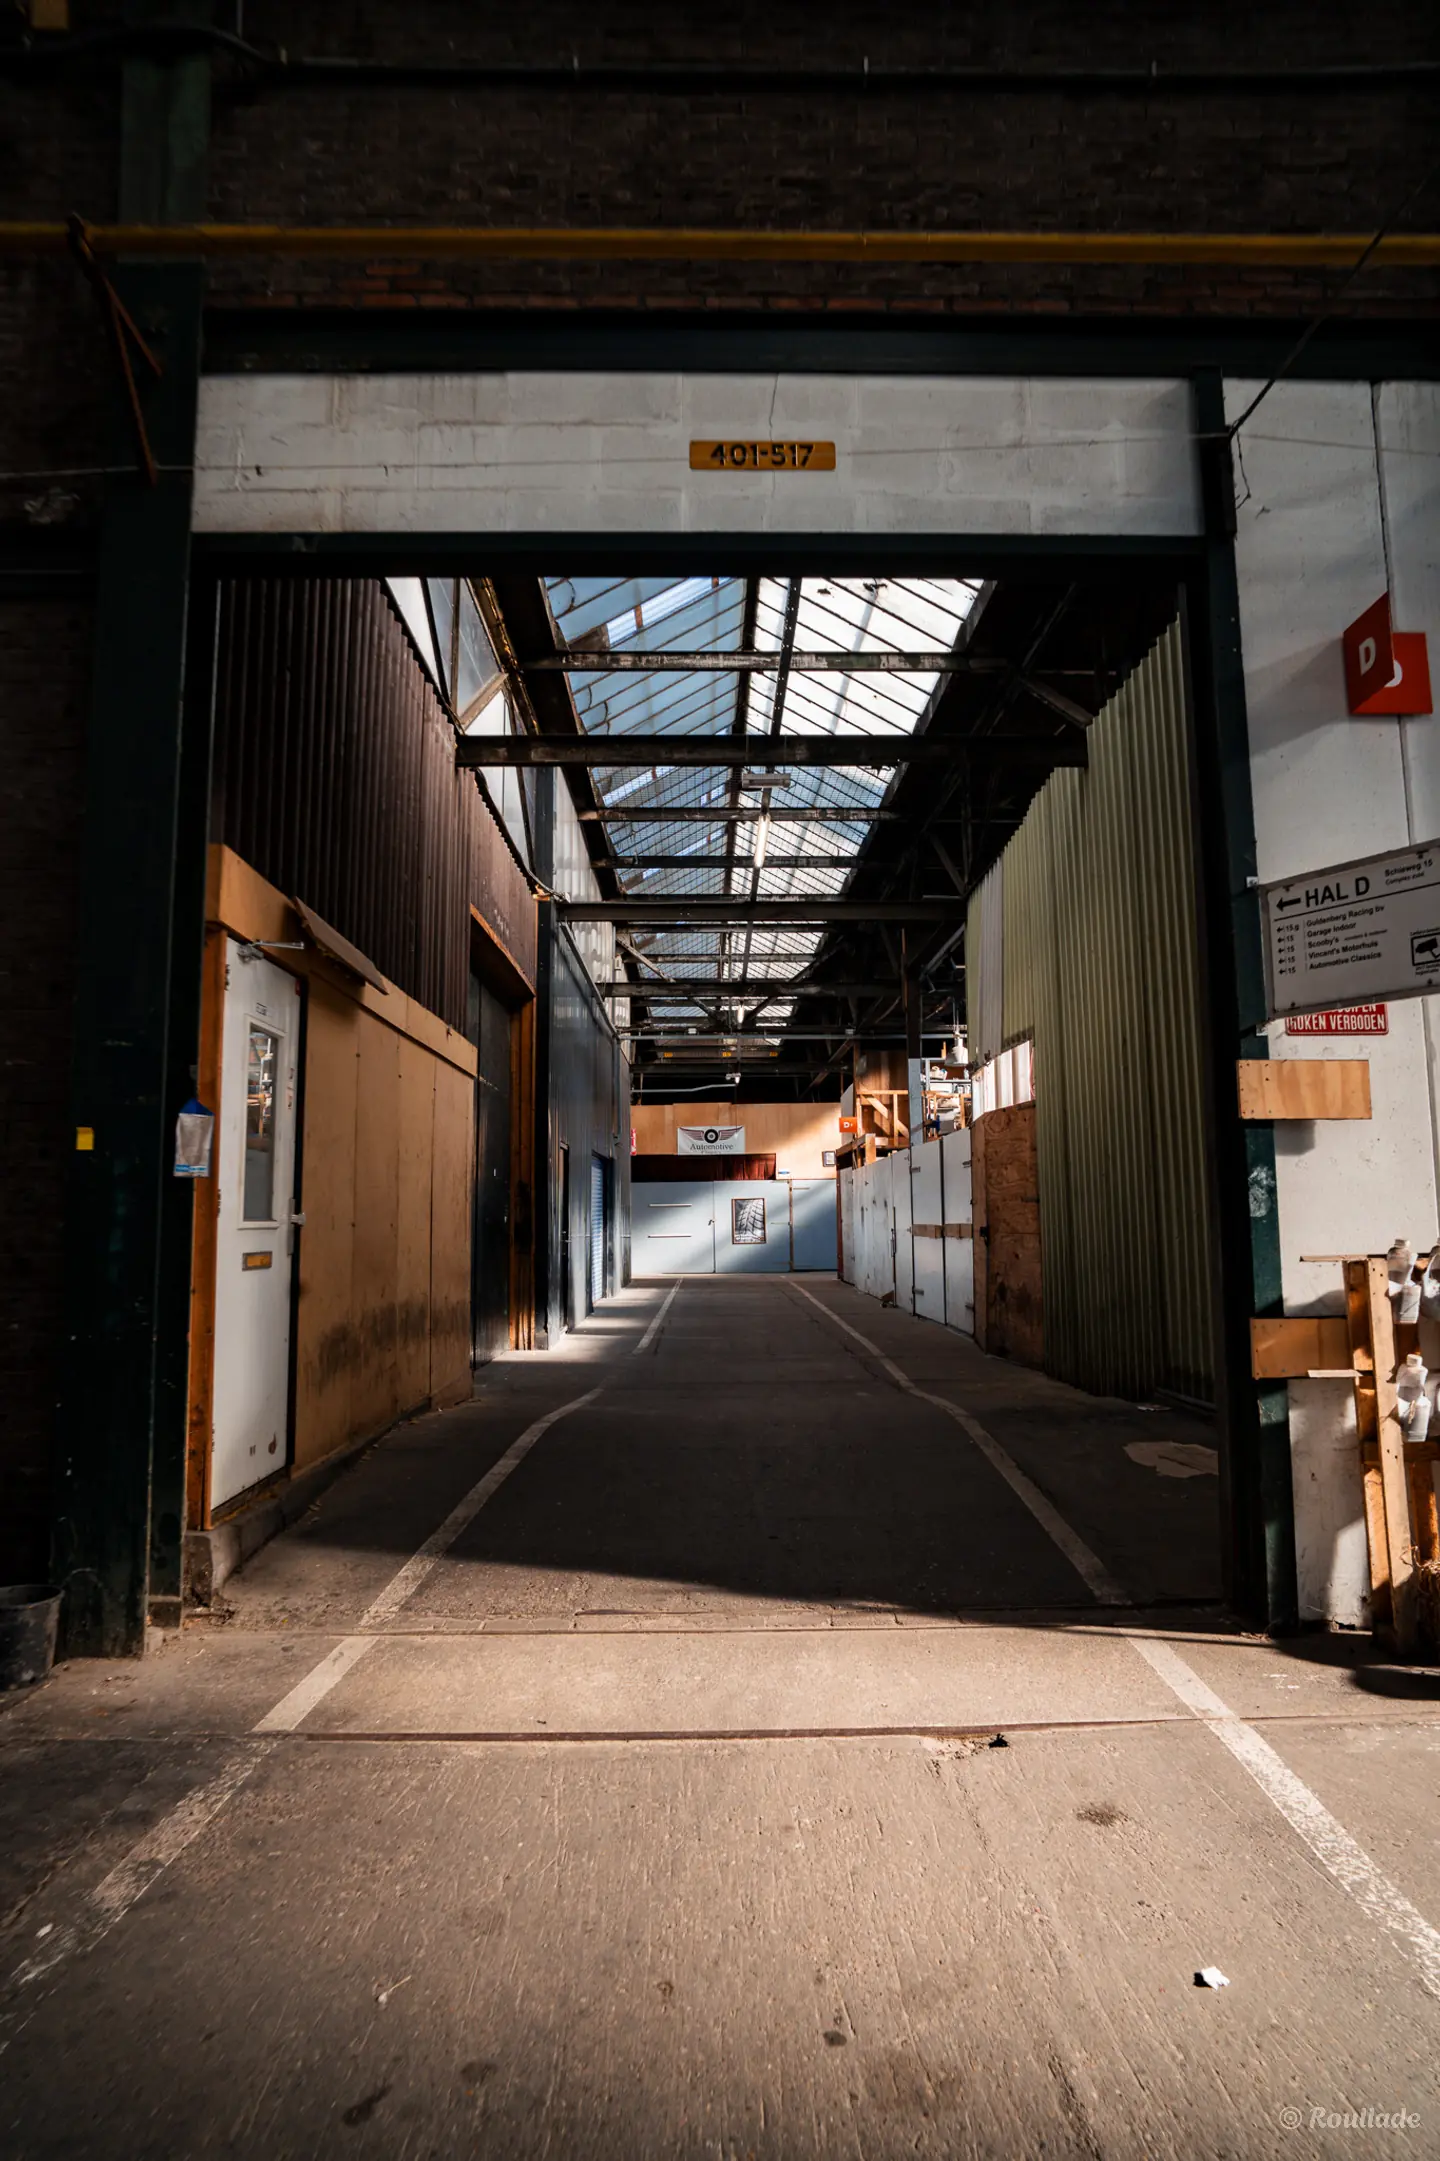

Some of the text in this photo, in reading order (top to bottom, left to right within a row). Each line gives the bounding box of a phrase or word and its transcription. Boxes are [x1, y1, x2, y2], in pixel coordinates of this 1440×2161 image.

[711, 443, 815, 467] 401-517
[1359, 636, 1376, 677] D
[1423, 859, 1434, 868] 15
[1305, 876, 1370, 908] HAL D
[1348, 907, 1374, 918] Racing
[1306, 928, 1332, 938] Garage
[1333, 922, 1357, 932] Indoor
[1287, 936, 1339, 953] 15 Scooby's
[1288, 955, 1296, 963] 15
[1308, 948, 1340, 959] Vincent's
[1288, 952, 1382, 974] 15 Automotive Classics
[1330, 1014, 1385, 1030] VERBODEN
[843, 1121, 850, 1129] D
